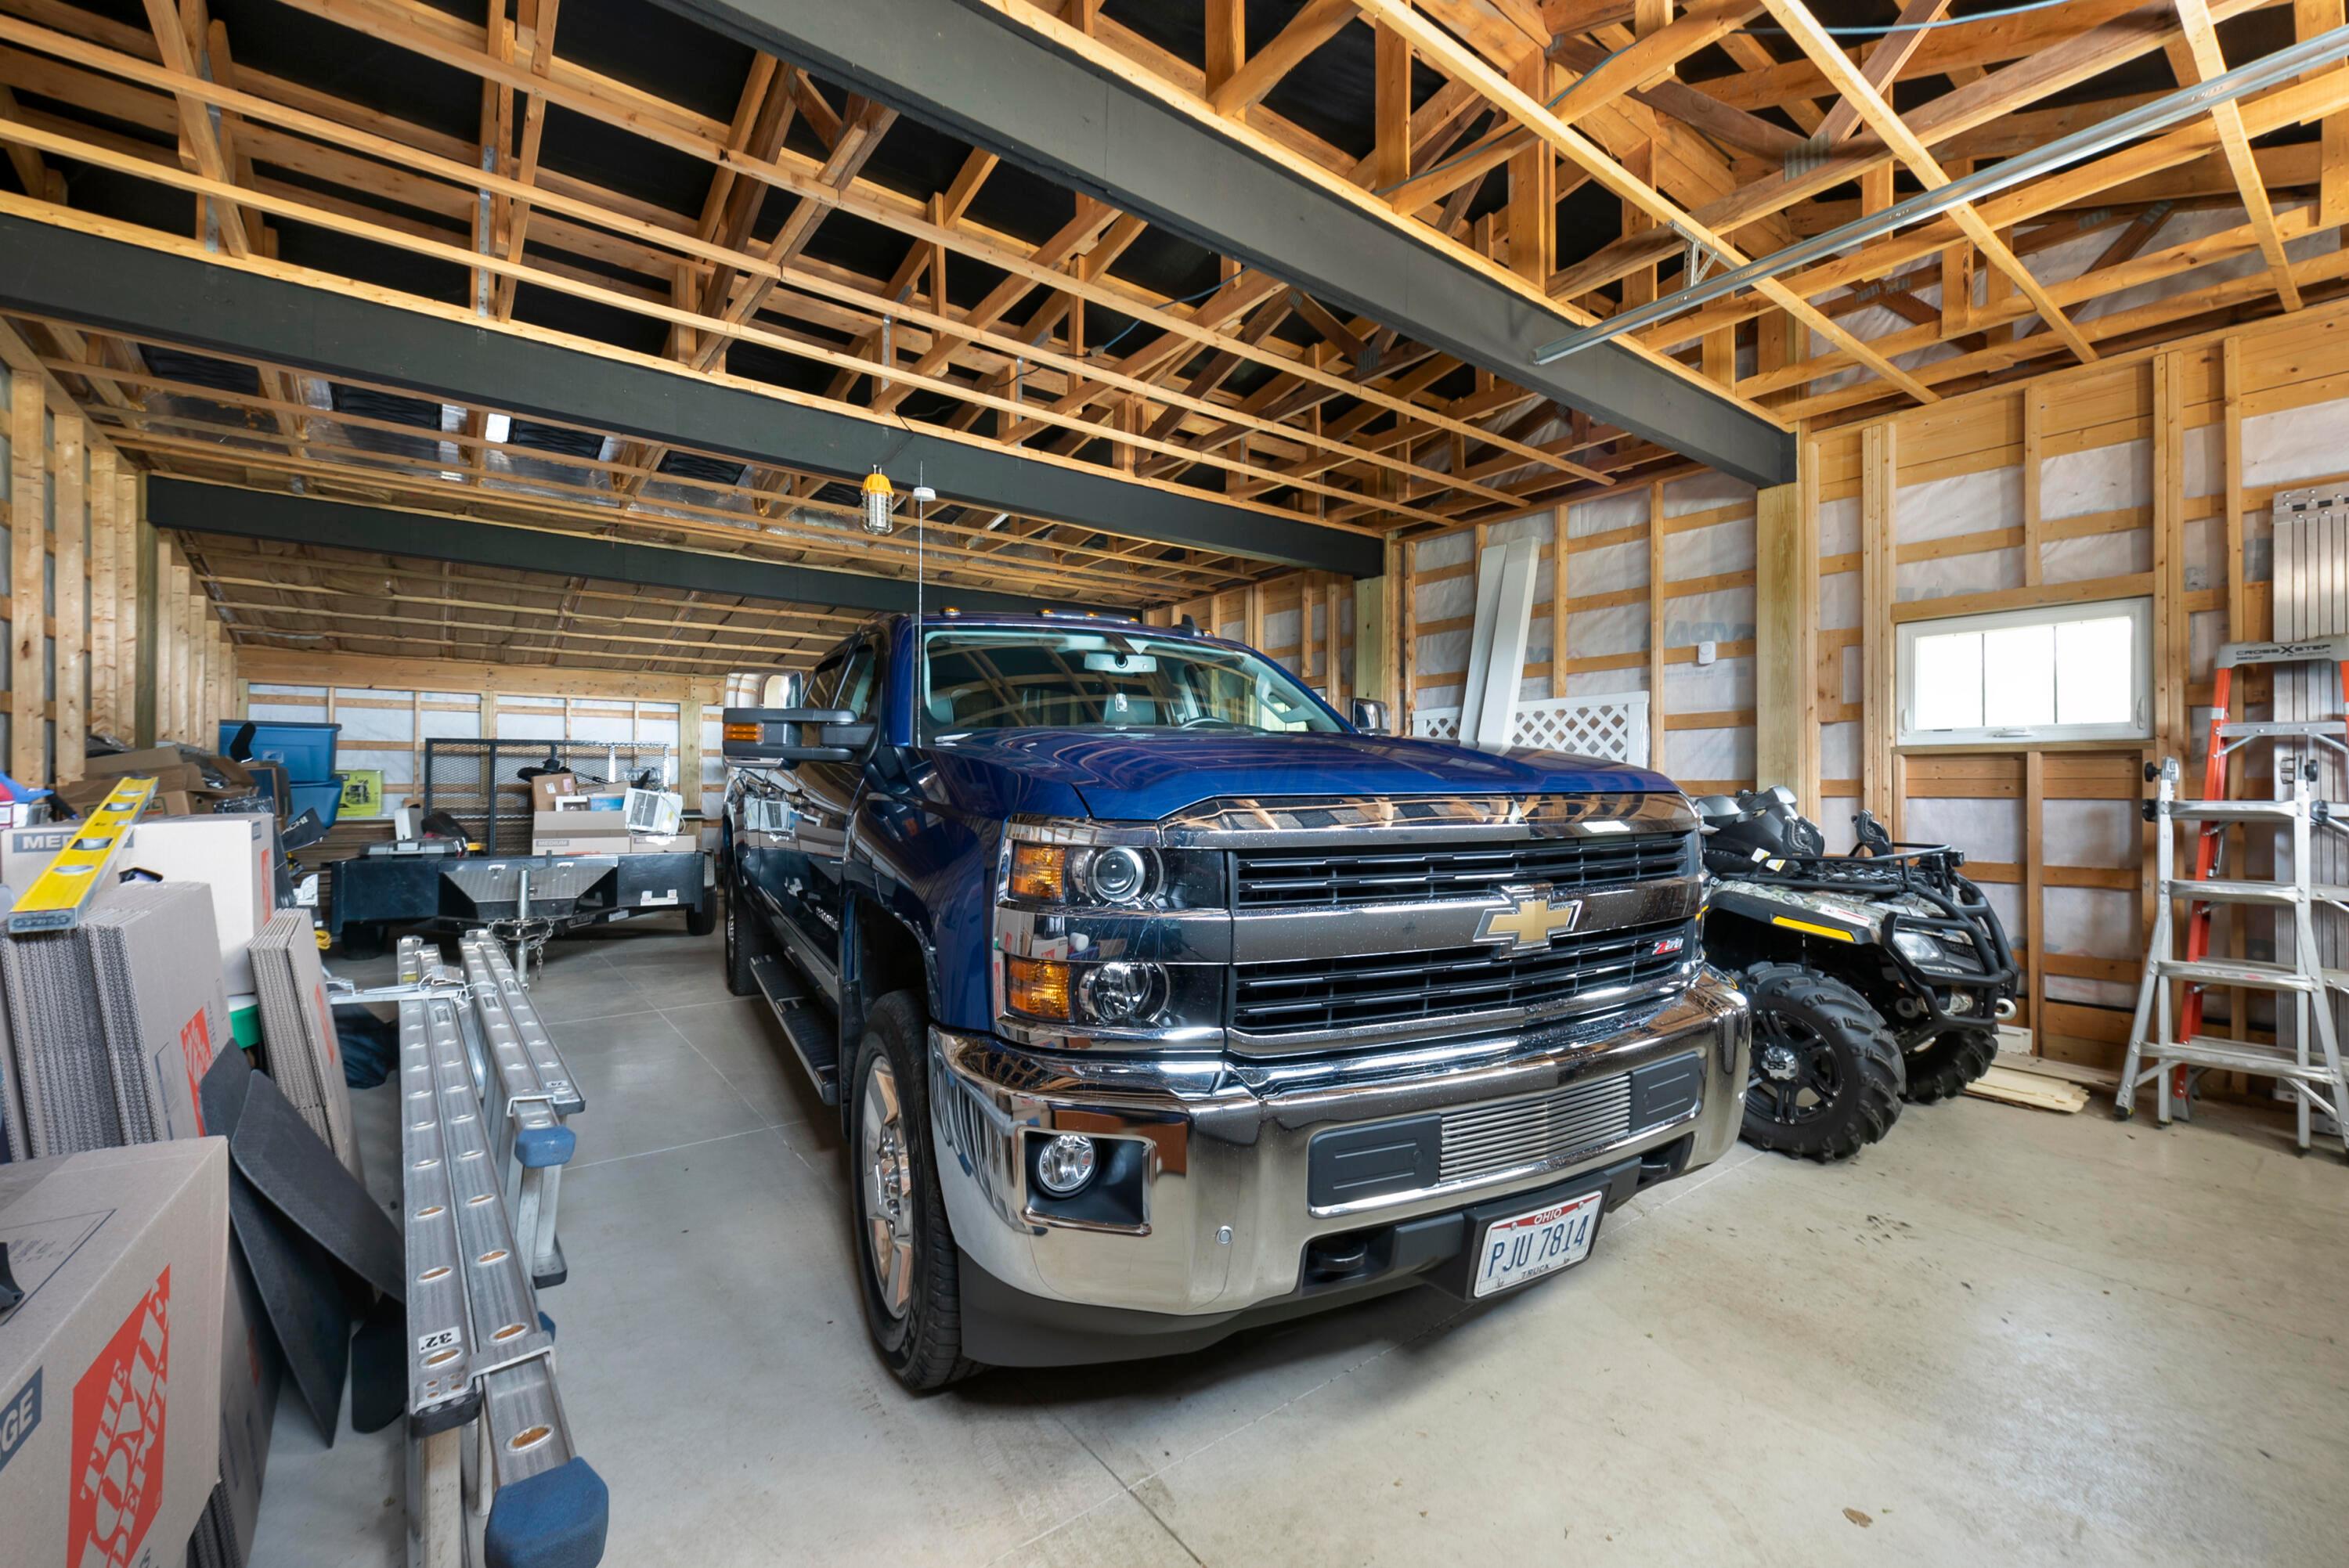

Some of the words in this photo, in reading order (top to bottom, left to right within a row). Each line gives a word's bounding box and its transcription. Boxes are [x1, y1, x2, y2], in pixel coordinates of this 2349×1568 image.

[1534, 1208, 1562, 1224] OHIO
[1488, 1232, 1535, 1278] PJU
[1537, 1214, 1589, 1262] 7814
[1521, 1263, 1551, 1279] TRUCK
[80, 1358, 128, 1500] THE
